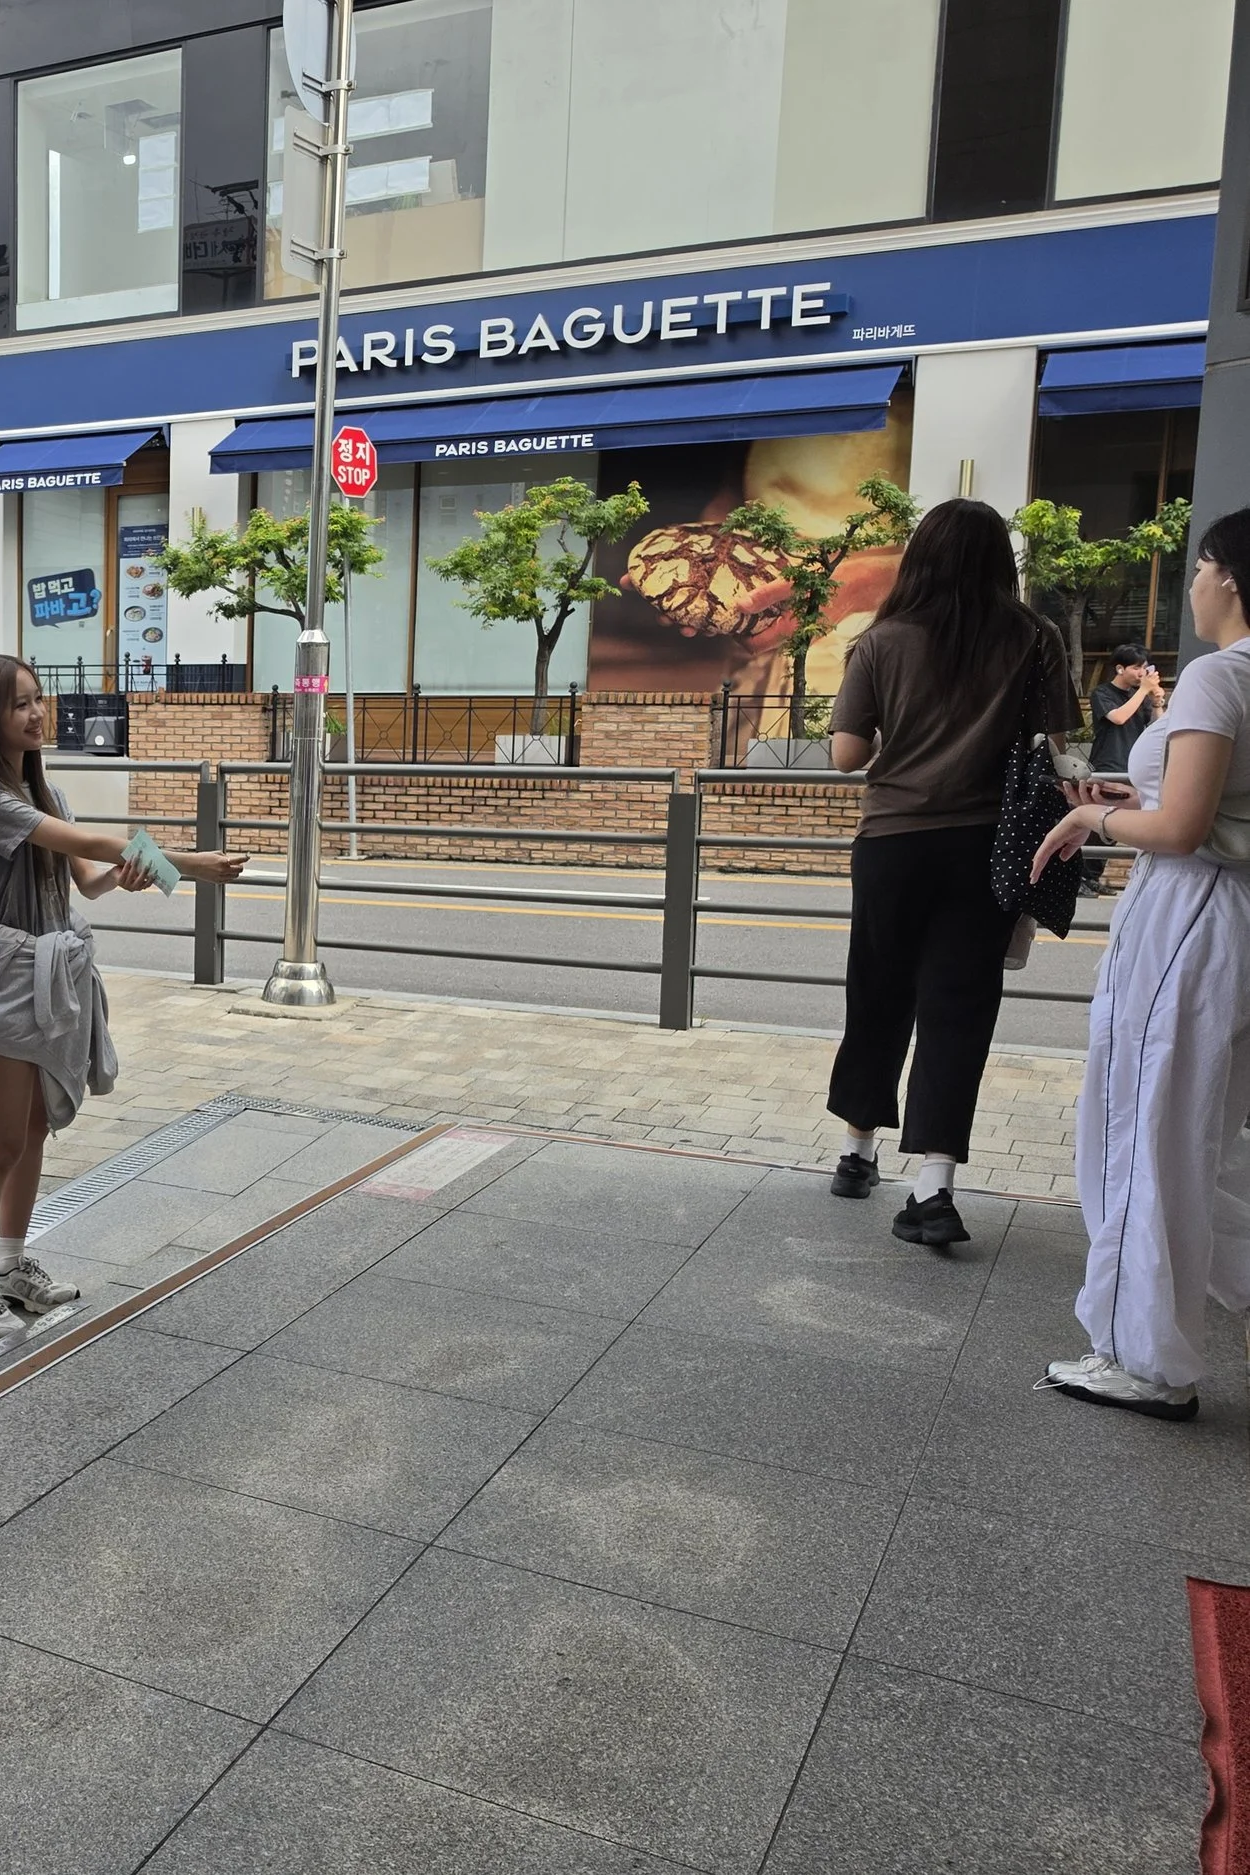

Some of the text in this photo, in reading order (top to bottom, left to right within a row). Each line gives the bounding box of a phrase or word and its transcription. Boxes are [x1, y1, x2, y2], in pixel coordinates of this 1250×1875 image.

[292, 282, 832, 378] PARIS BAGUETTE
[852, 323, 916, 342] 파리바게뜨
[338, 438, 370, 466] 정지
[435, 433, 594, 457] PARIS BAGUETTE
[28, 472, 102, 488] BAGUETTE
[338, 466, 370, 487] STOP
[32, 577, 75, 599] 밥 먹고
